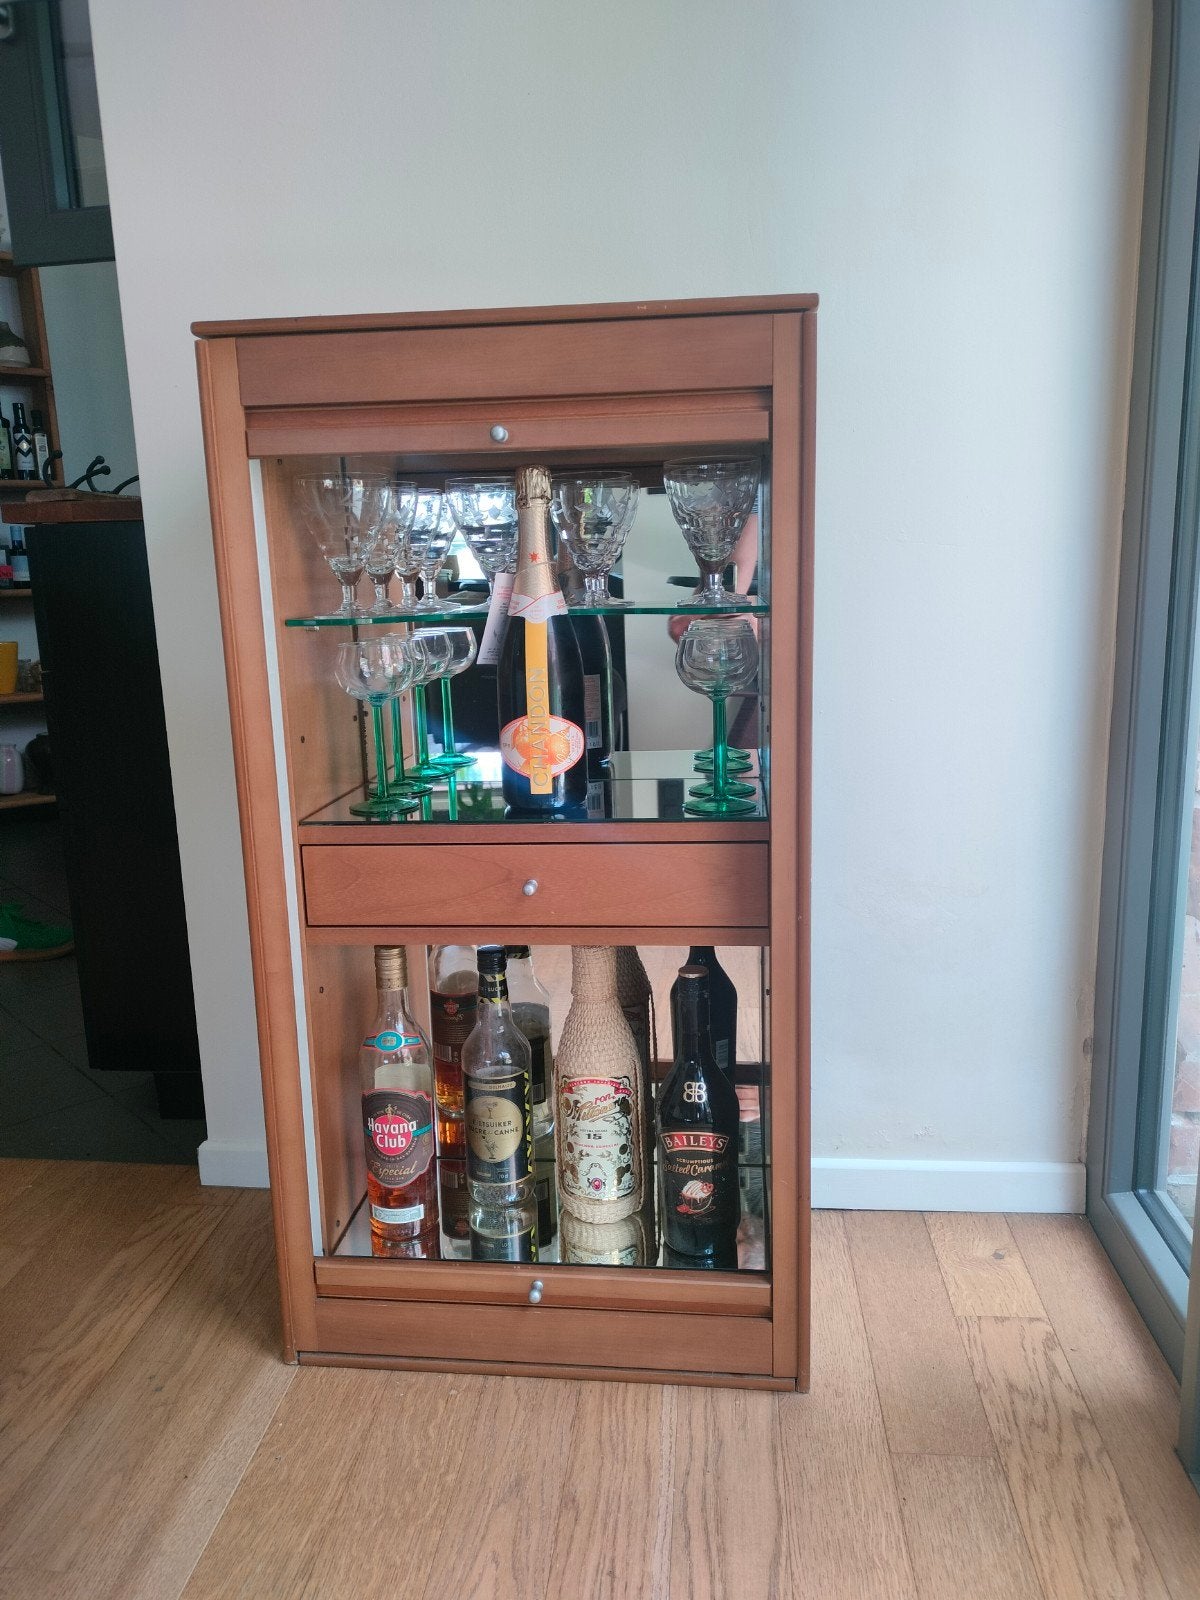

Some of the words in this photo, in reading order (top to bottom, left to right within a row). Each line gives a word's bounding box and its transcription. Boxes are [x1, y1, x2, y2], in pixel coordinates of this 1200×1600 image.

[528, 668, 549, 787] CHANDON
[367, 1117, 417, 1134] Havana
[376, 1134, 407, 1148] Club
[664, 1135, 724, 1149] BAILEYS
[371, 1160, 418, 1179] Especial
